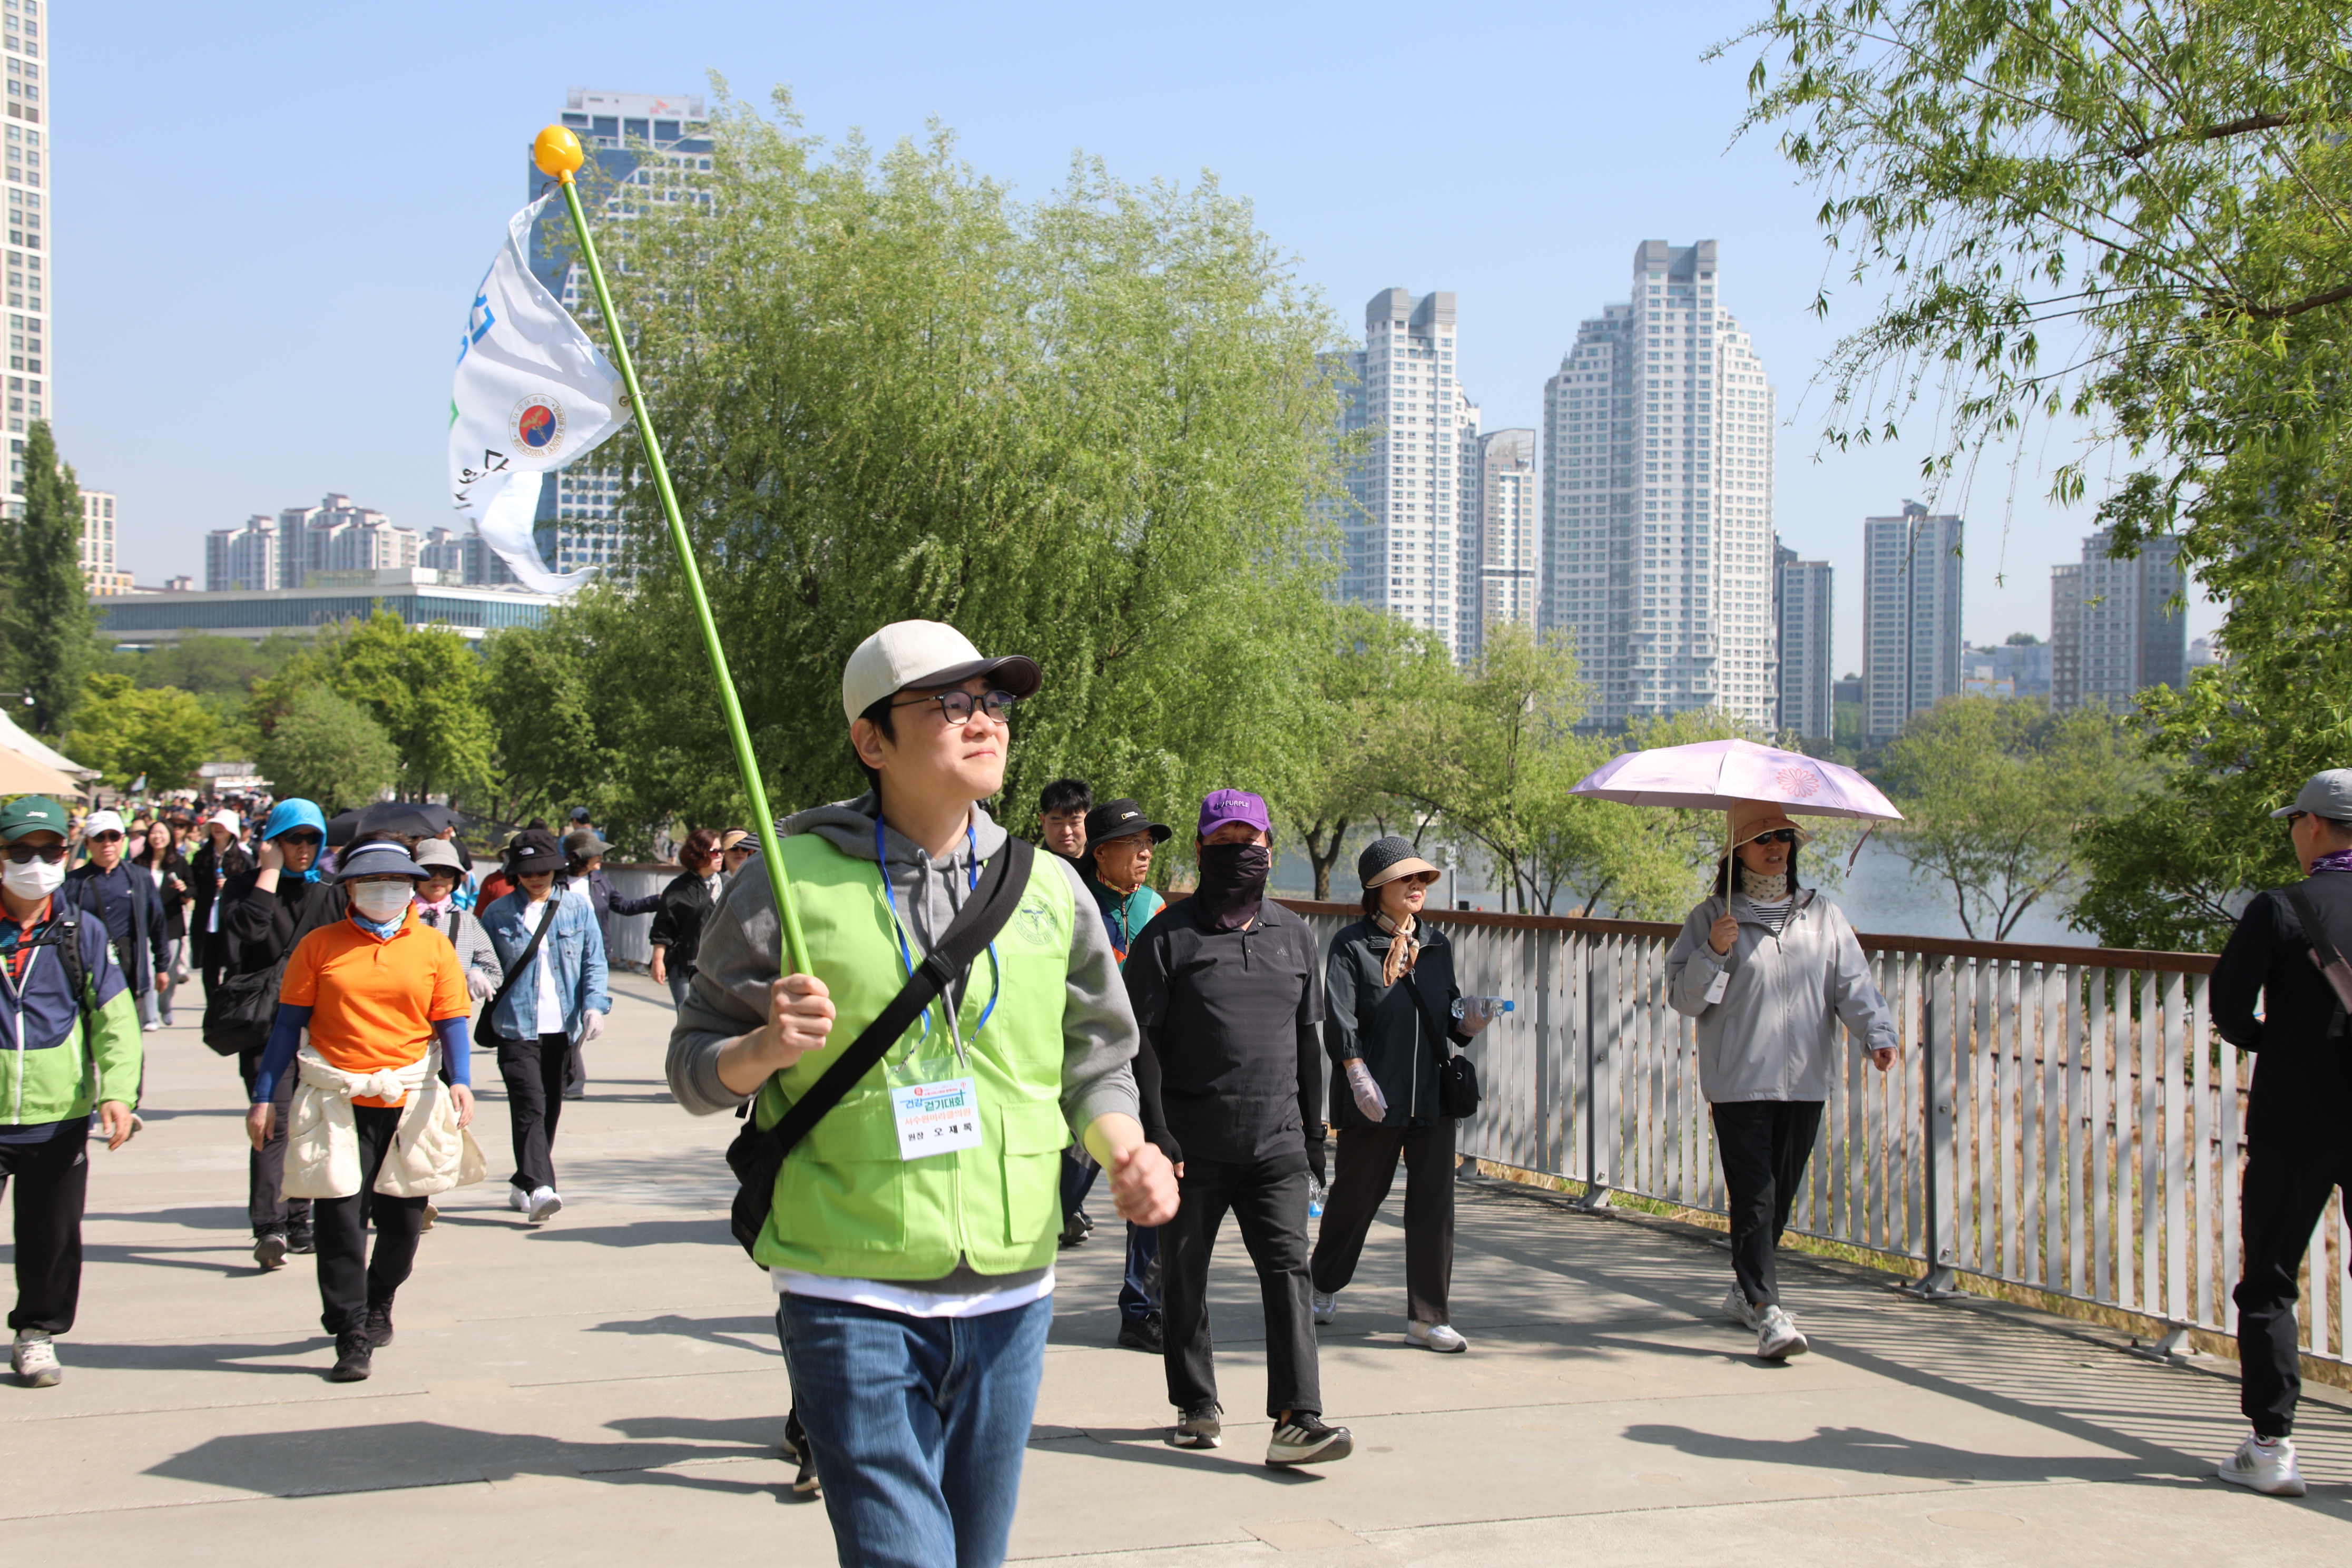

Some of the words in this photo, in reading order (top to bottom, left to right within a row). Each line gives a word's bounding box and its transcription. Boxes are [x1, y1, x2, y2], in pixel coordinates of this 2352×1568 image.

[906, 1099, 923, 1109] 건강
[925, 1089, 964, 1111] 걷기대회
[908, 1132, 924, 1141] 원장
